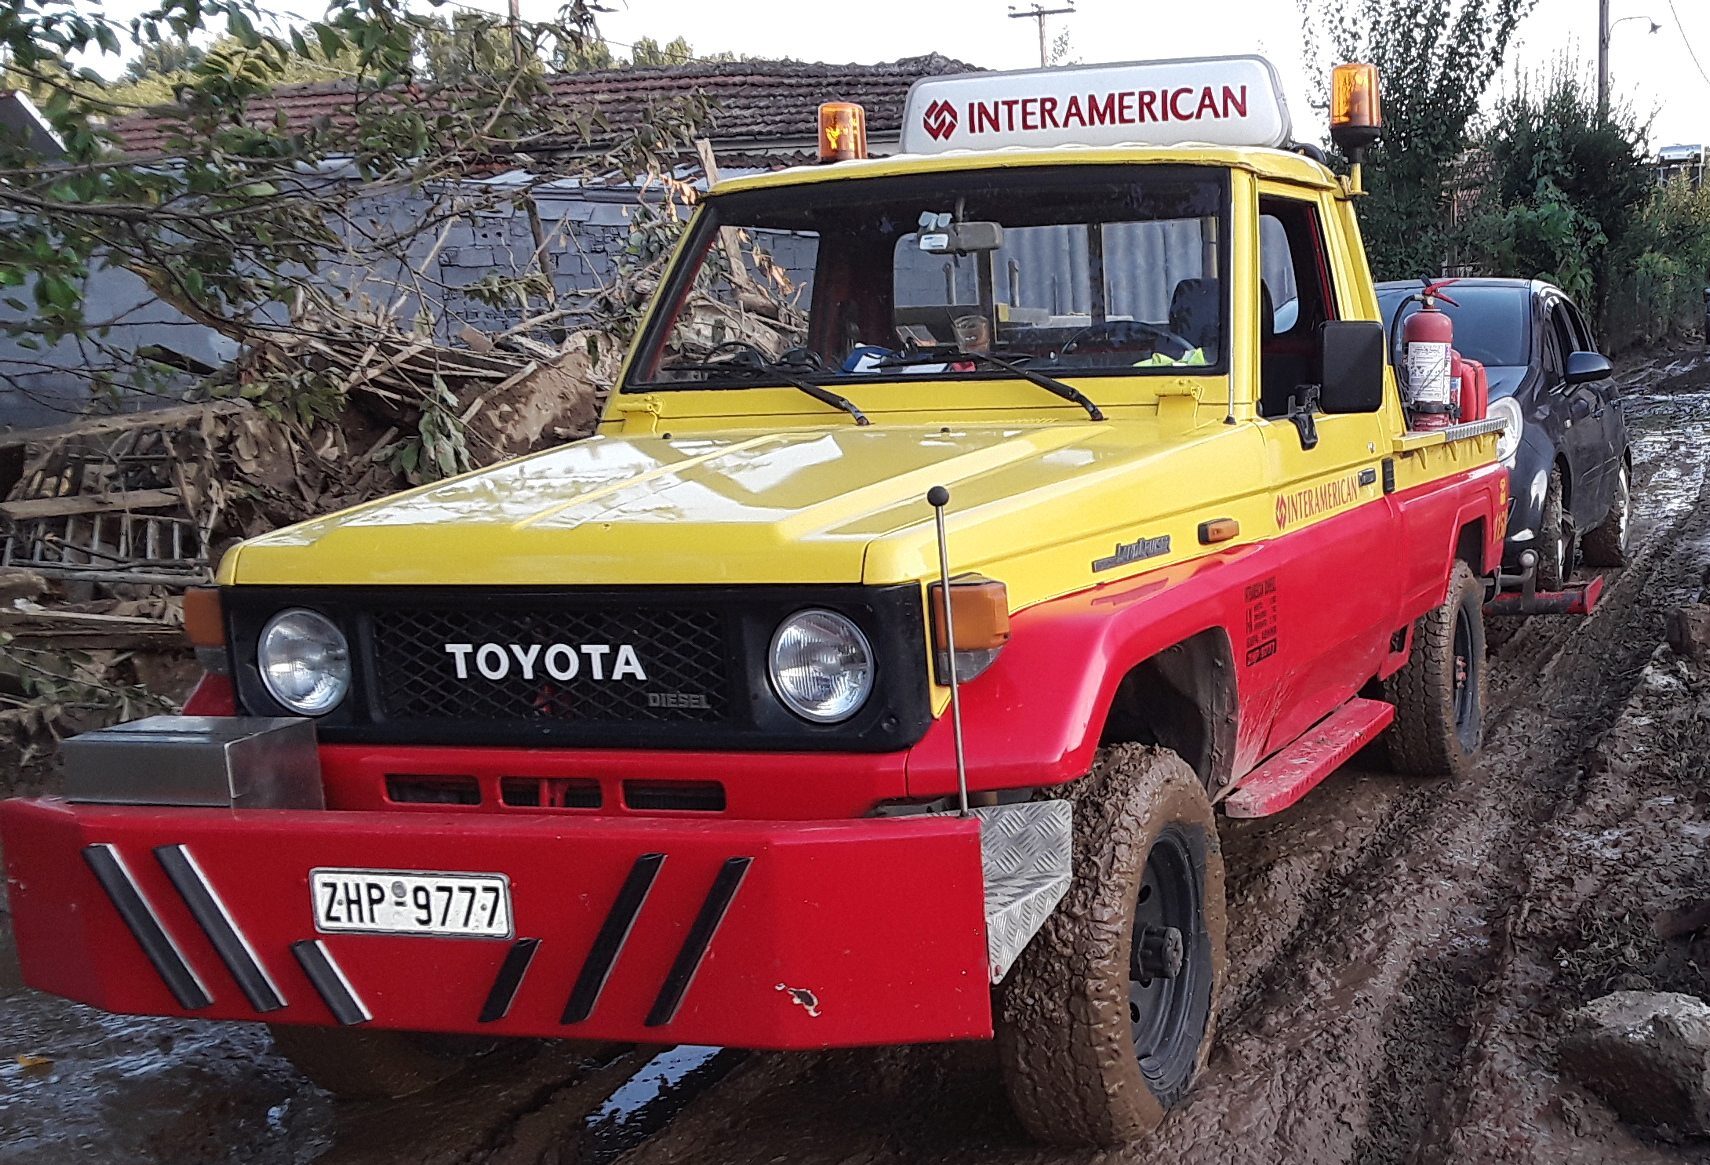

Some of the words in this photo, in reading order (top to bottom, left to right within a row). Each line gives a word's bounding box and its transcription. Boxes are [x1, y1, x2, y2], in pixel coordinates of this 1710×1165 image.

[968, 85, 1247, 134] INTERAMERICAN
[1287, 475, 1358, 523] INTERAMERICAN
[445, 643, 648, 681] TOYOTA
[648, 692, 712, 709] DIESEL
